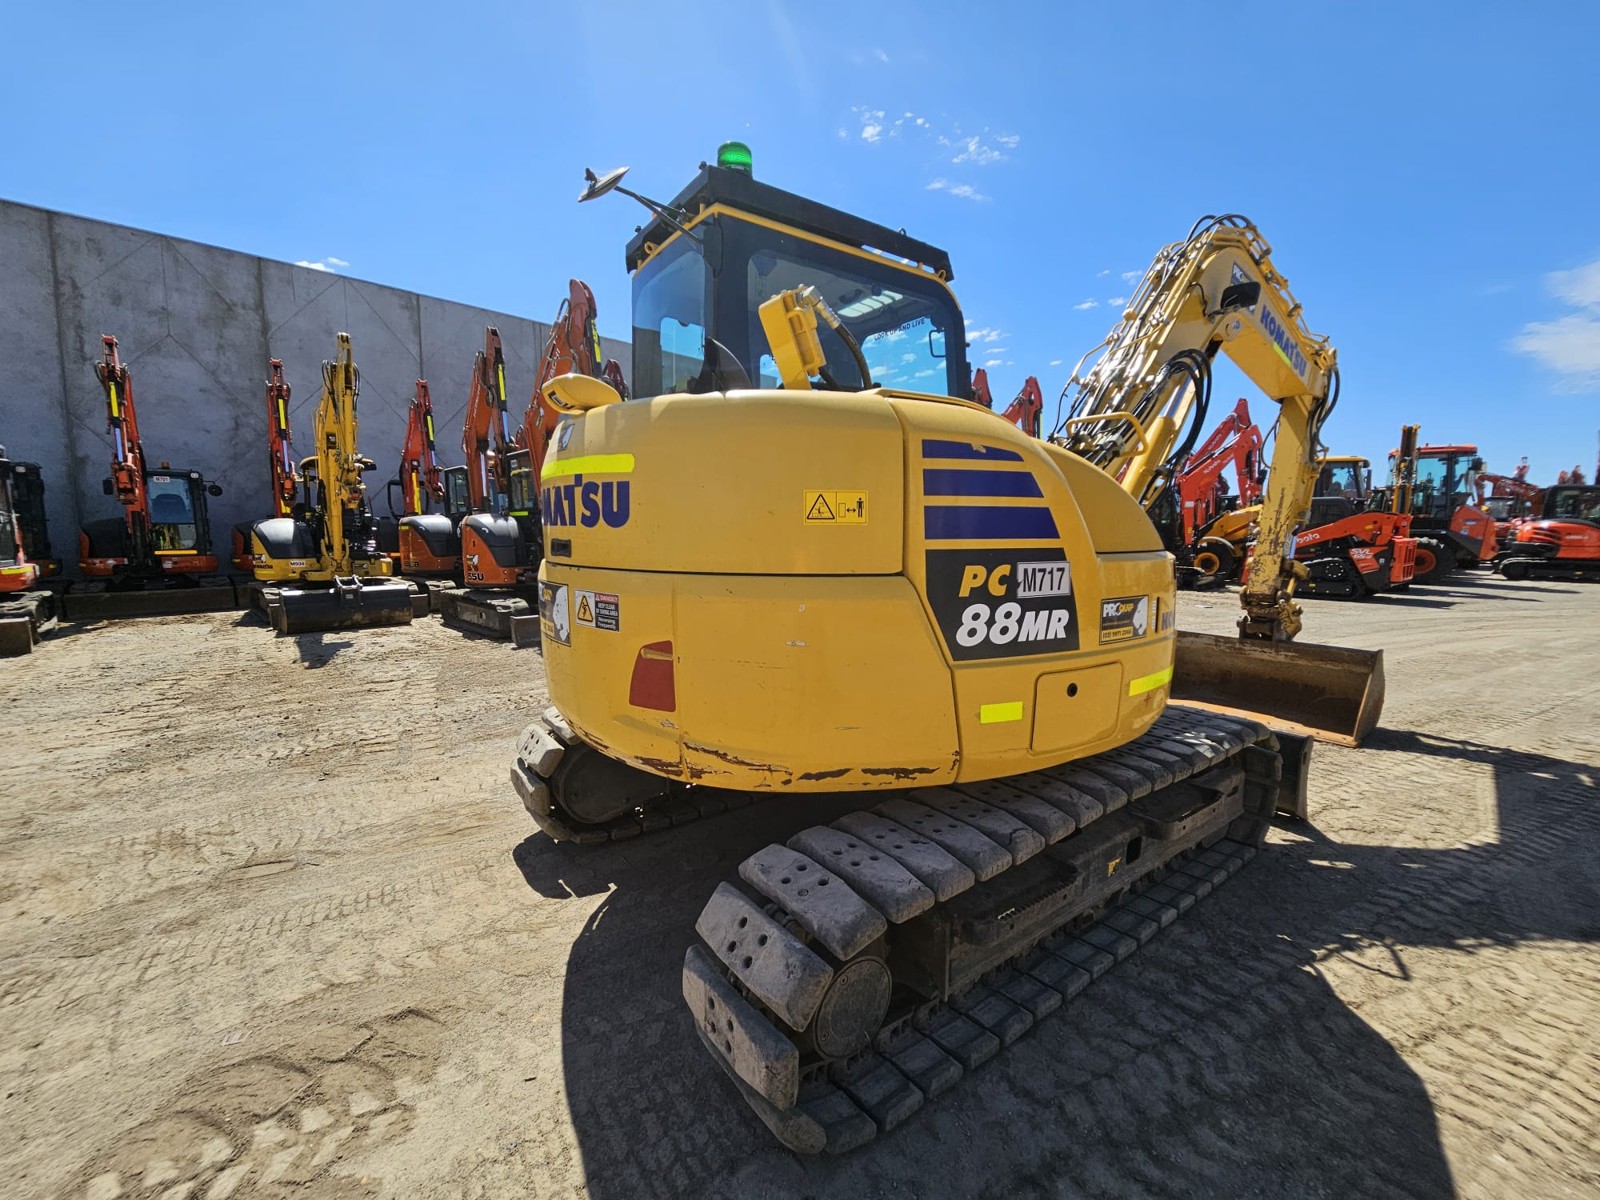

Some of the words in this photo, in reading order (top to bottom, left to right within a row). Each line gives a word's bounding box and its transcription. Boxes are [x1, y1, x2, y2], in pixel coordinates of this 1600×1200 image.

[874, 331, 889, 341] LOOK
[912, 317, 925, 328] LIVE
[1261, 304, 1307, 377] KOMATSU
[542, 473, 630, 529] MATSU
[1297, 532, 1320, 544] bota
[958, 564, 1012, 598] PC
[1022, 567, 1066, 593] M717
[955, 602, 1070, 648] 88MR
